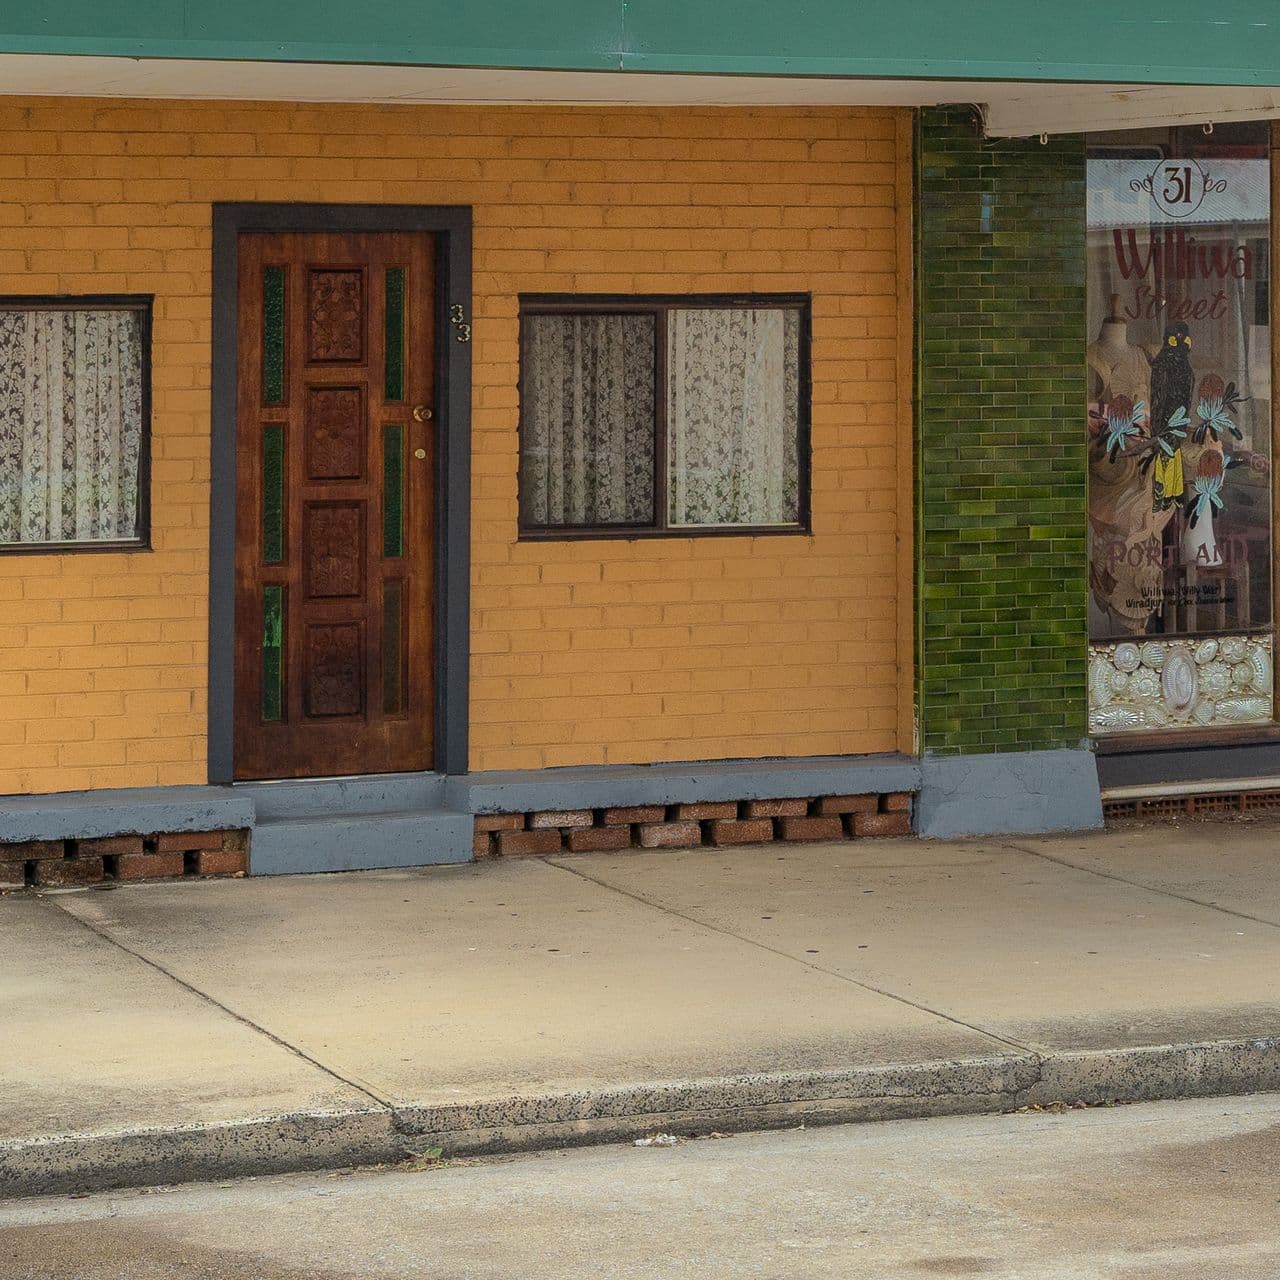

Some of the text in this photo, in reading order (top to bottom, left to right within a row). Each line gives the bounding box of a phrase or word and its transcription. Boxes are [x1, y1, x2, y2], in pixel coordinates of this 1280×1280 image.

[1163, 167, 1192, 204] 31
[1113, 227, 1252, 281] Williwa
[1125, 285, 1227, 320] Street
[451, 304, 470, 342] 33
